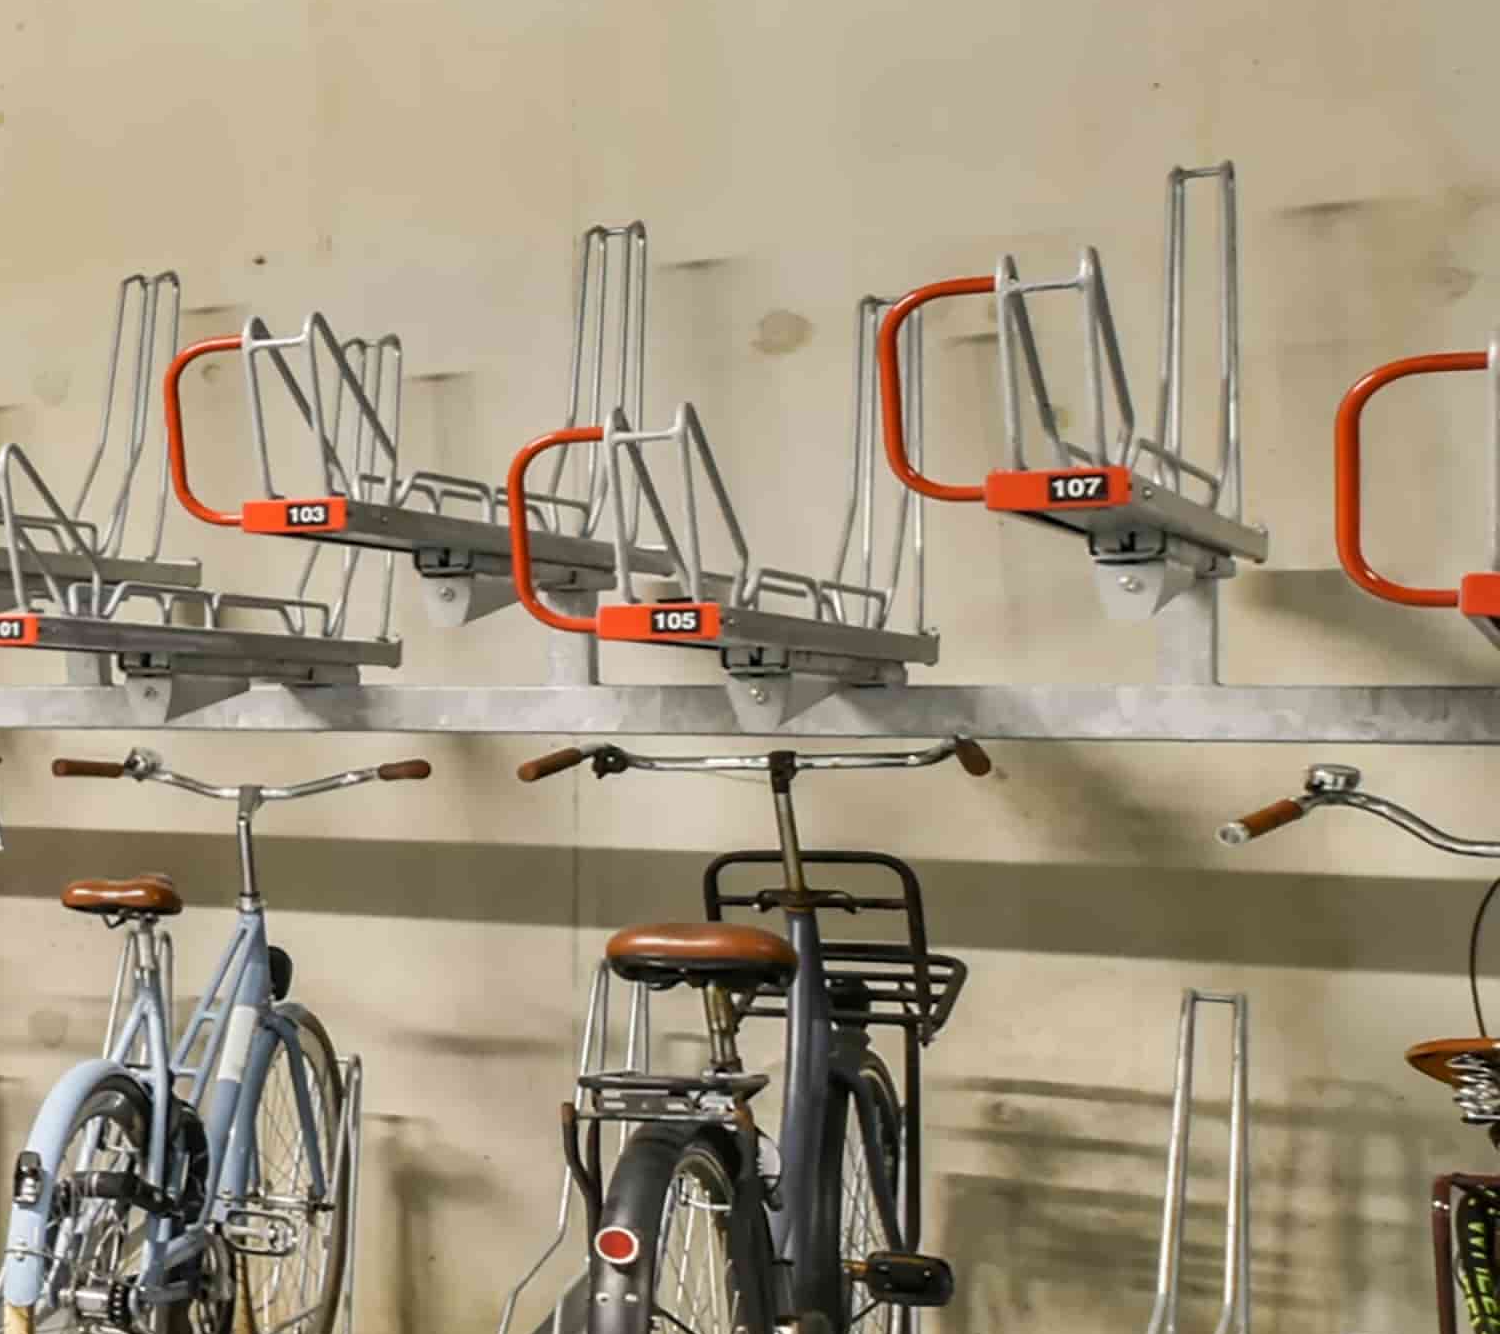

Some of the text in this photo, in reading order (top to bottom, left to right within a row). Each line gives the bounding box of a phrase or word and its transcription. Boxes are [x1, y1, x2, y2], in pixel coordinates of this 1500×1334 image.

[1052, 477, 1102, 498] 107
[289, 505, 325, 523] 103
[654, 611, 697, 630] 105
